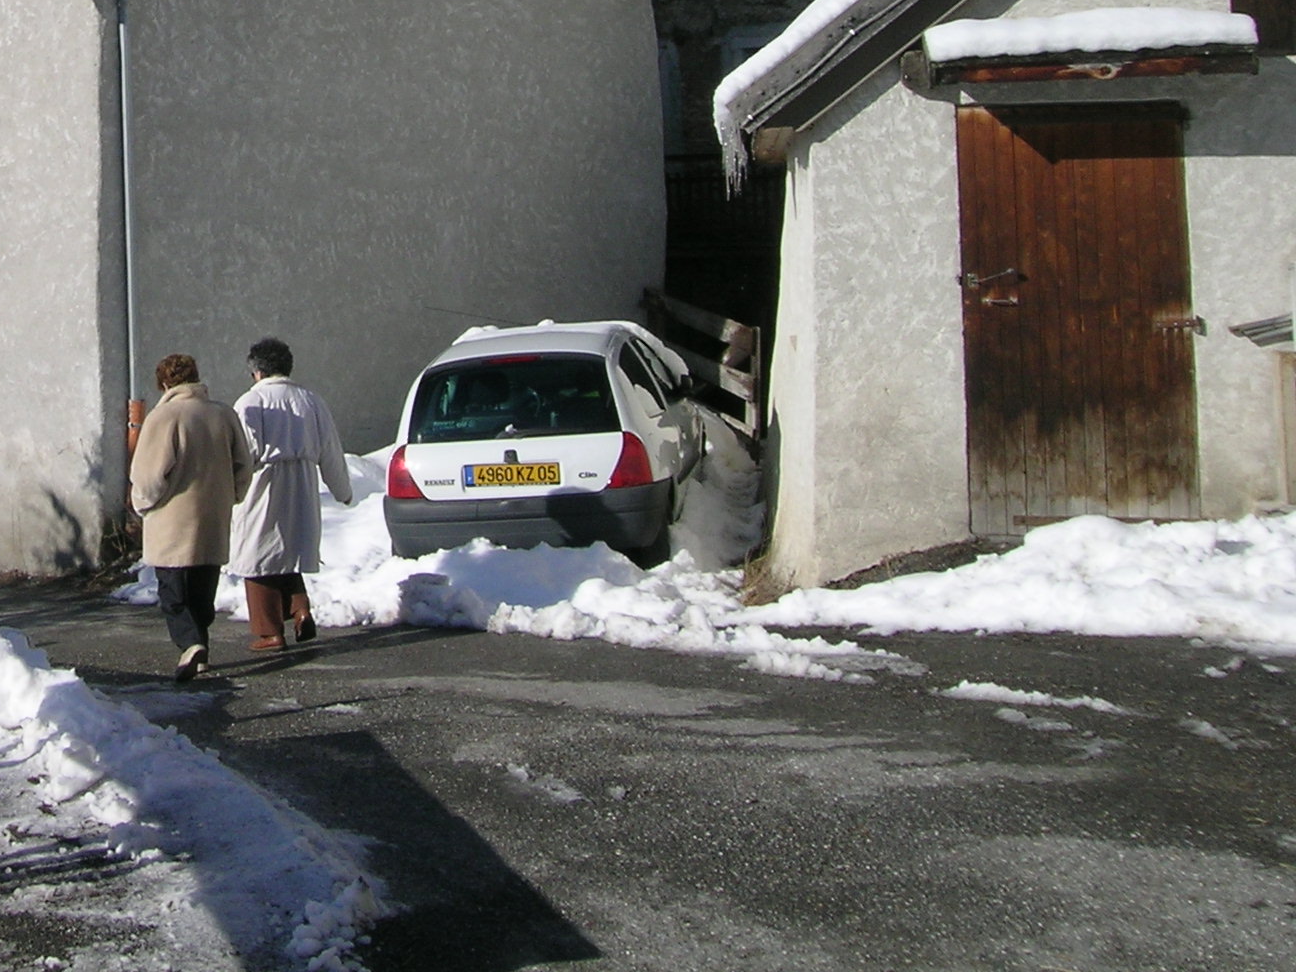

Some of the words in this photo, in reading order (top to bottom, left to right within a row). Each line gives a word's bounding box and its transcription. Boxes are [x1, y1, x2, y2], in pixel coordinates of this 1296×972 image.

[477, 466, 513, 482] 4960
[517, 466, 535, 481] KZ
[537, 465, 556, 480] 05
